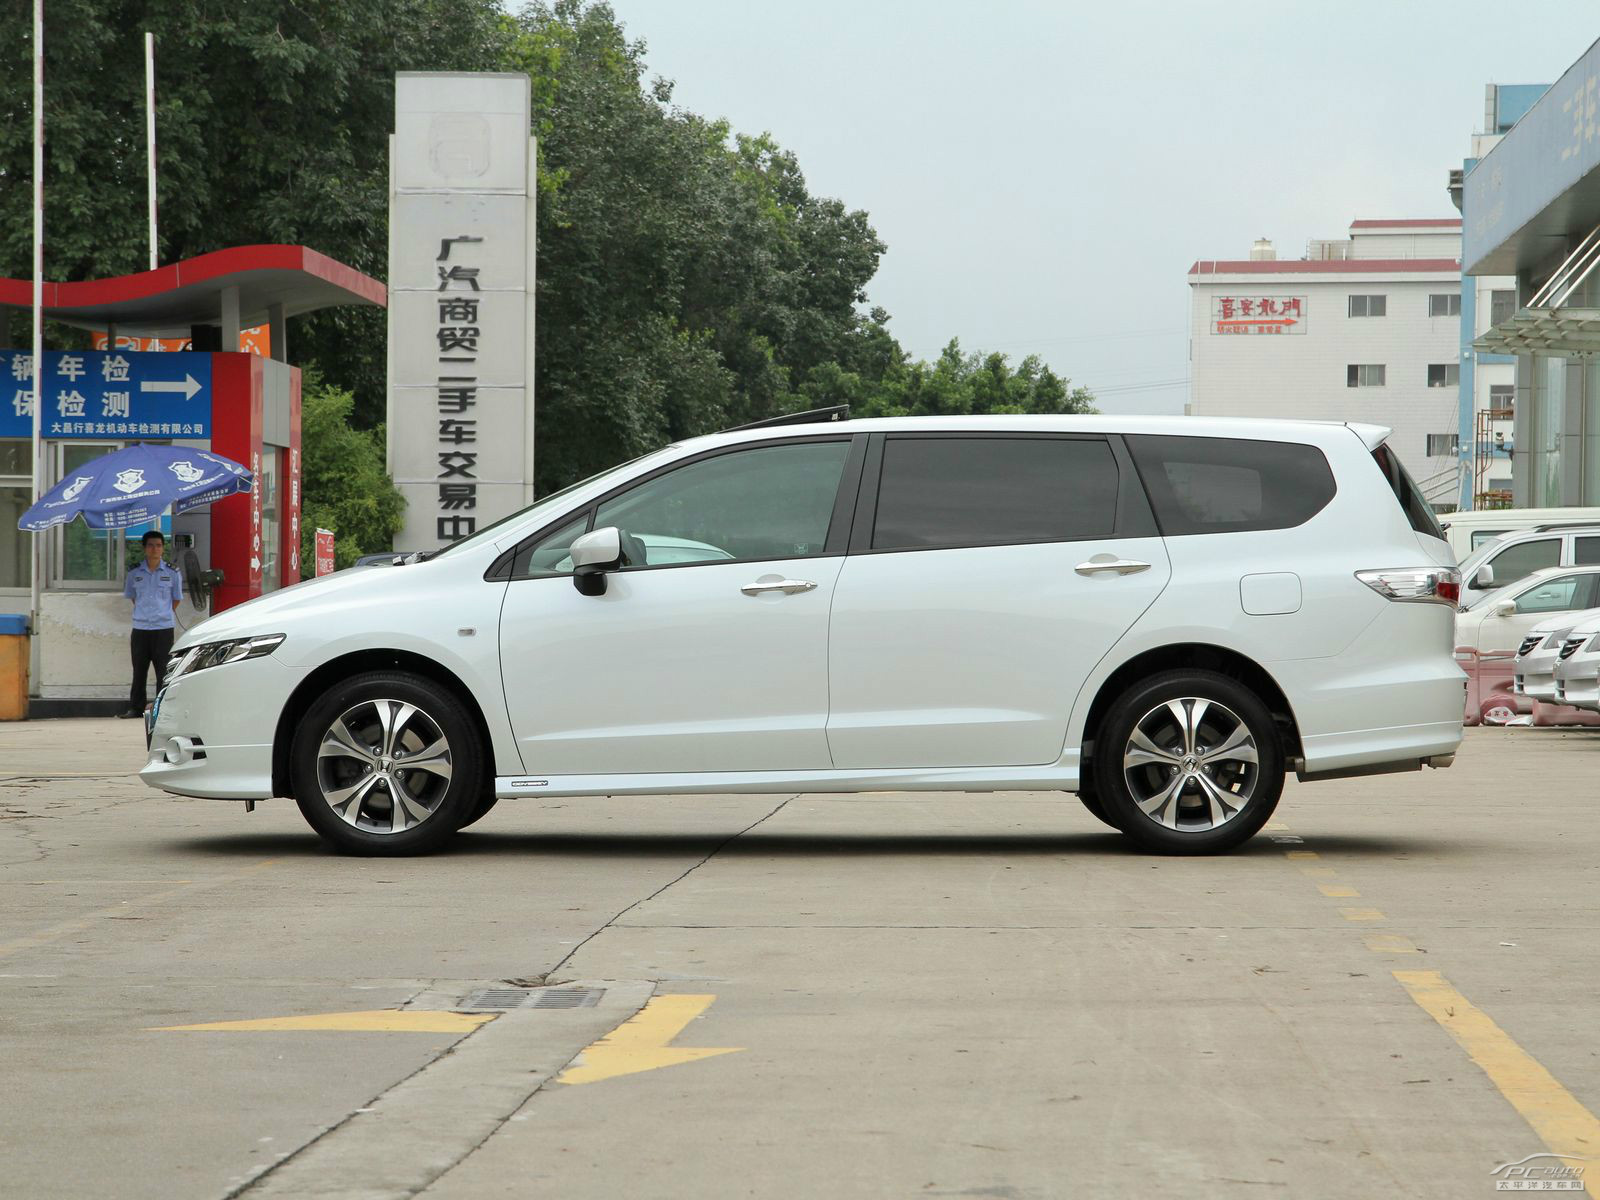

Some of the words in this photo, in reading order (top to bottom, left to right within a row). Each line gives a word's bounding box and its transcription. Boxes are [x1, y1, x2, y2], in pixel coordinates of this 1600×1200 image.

[0, 354, 130, 382] 辆年检
[437, 235, 483, 541] 广汽商贸二手车交易中
